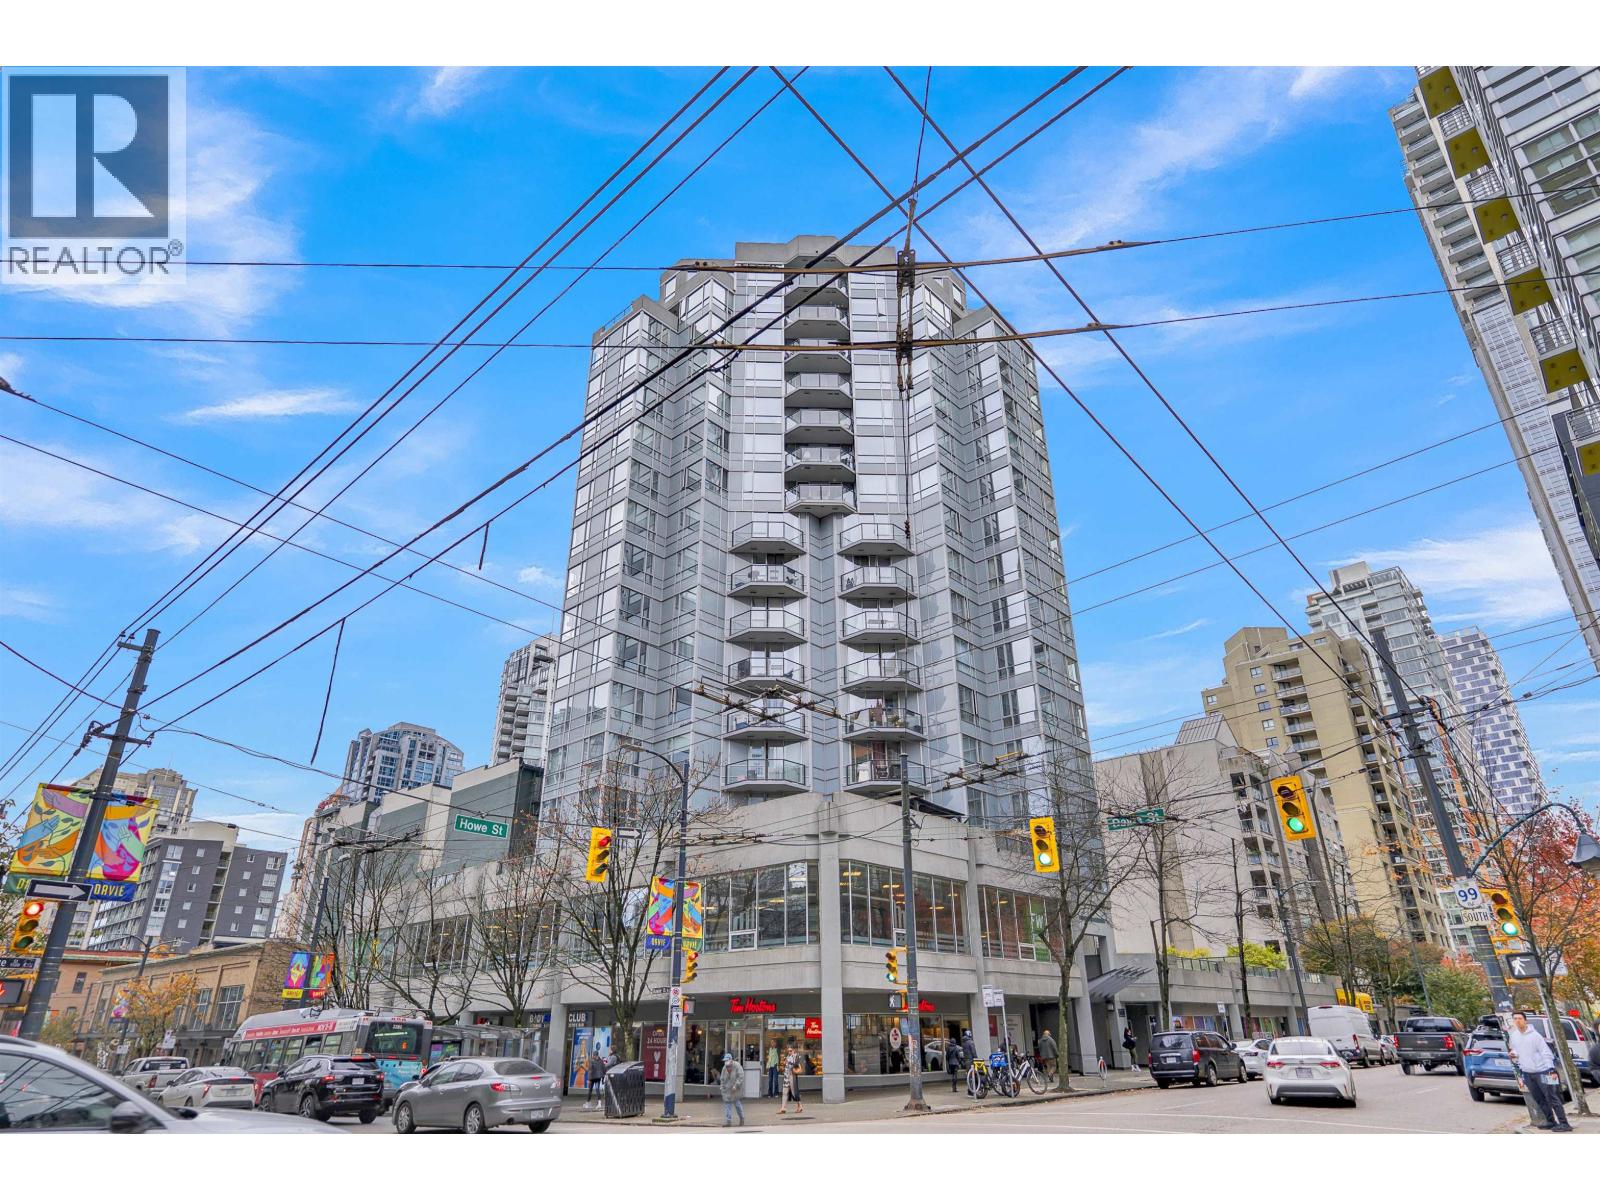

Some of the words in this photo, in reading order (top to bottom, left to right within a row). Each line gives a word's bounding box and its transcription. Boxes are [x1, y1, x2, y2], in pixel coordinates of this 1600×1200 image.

[459, 818, 488, 833] Howe
[491, 824, 504, 836] St
[94, 883, 126, 897] DAVIE
[1458, 887, 1478, 902] 99
[1463, 911, 1490, 923] SOUTH
[729, 997, 744, 1013] Tim
[744, 996, 777, 1013] Hortons
[568, 1013, 586, 1022] CLUB
